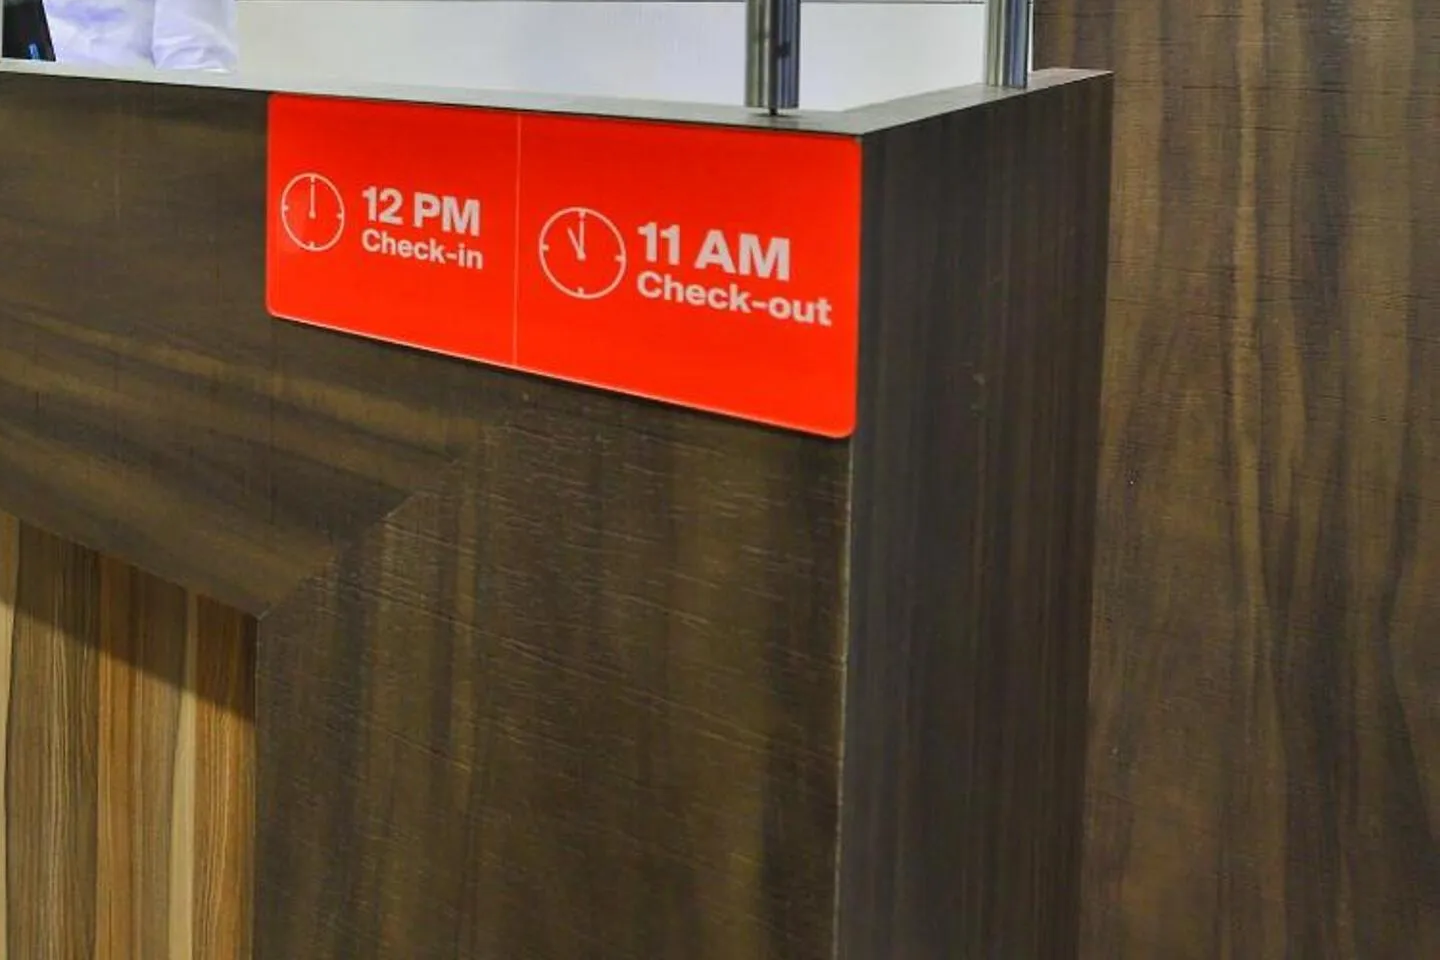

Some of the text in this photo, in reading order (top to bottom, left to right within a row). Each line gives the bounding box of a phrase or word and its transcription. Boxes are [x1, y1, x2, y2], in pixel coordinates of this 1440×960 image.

[361, 185, 481, 237] 12 PM
[361, 229, 483, 270] Check-in
[637, 222, 791, 282] 11 AM
[636, 270, 832, 327] Check-out
